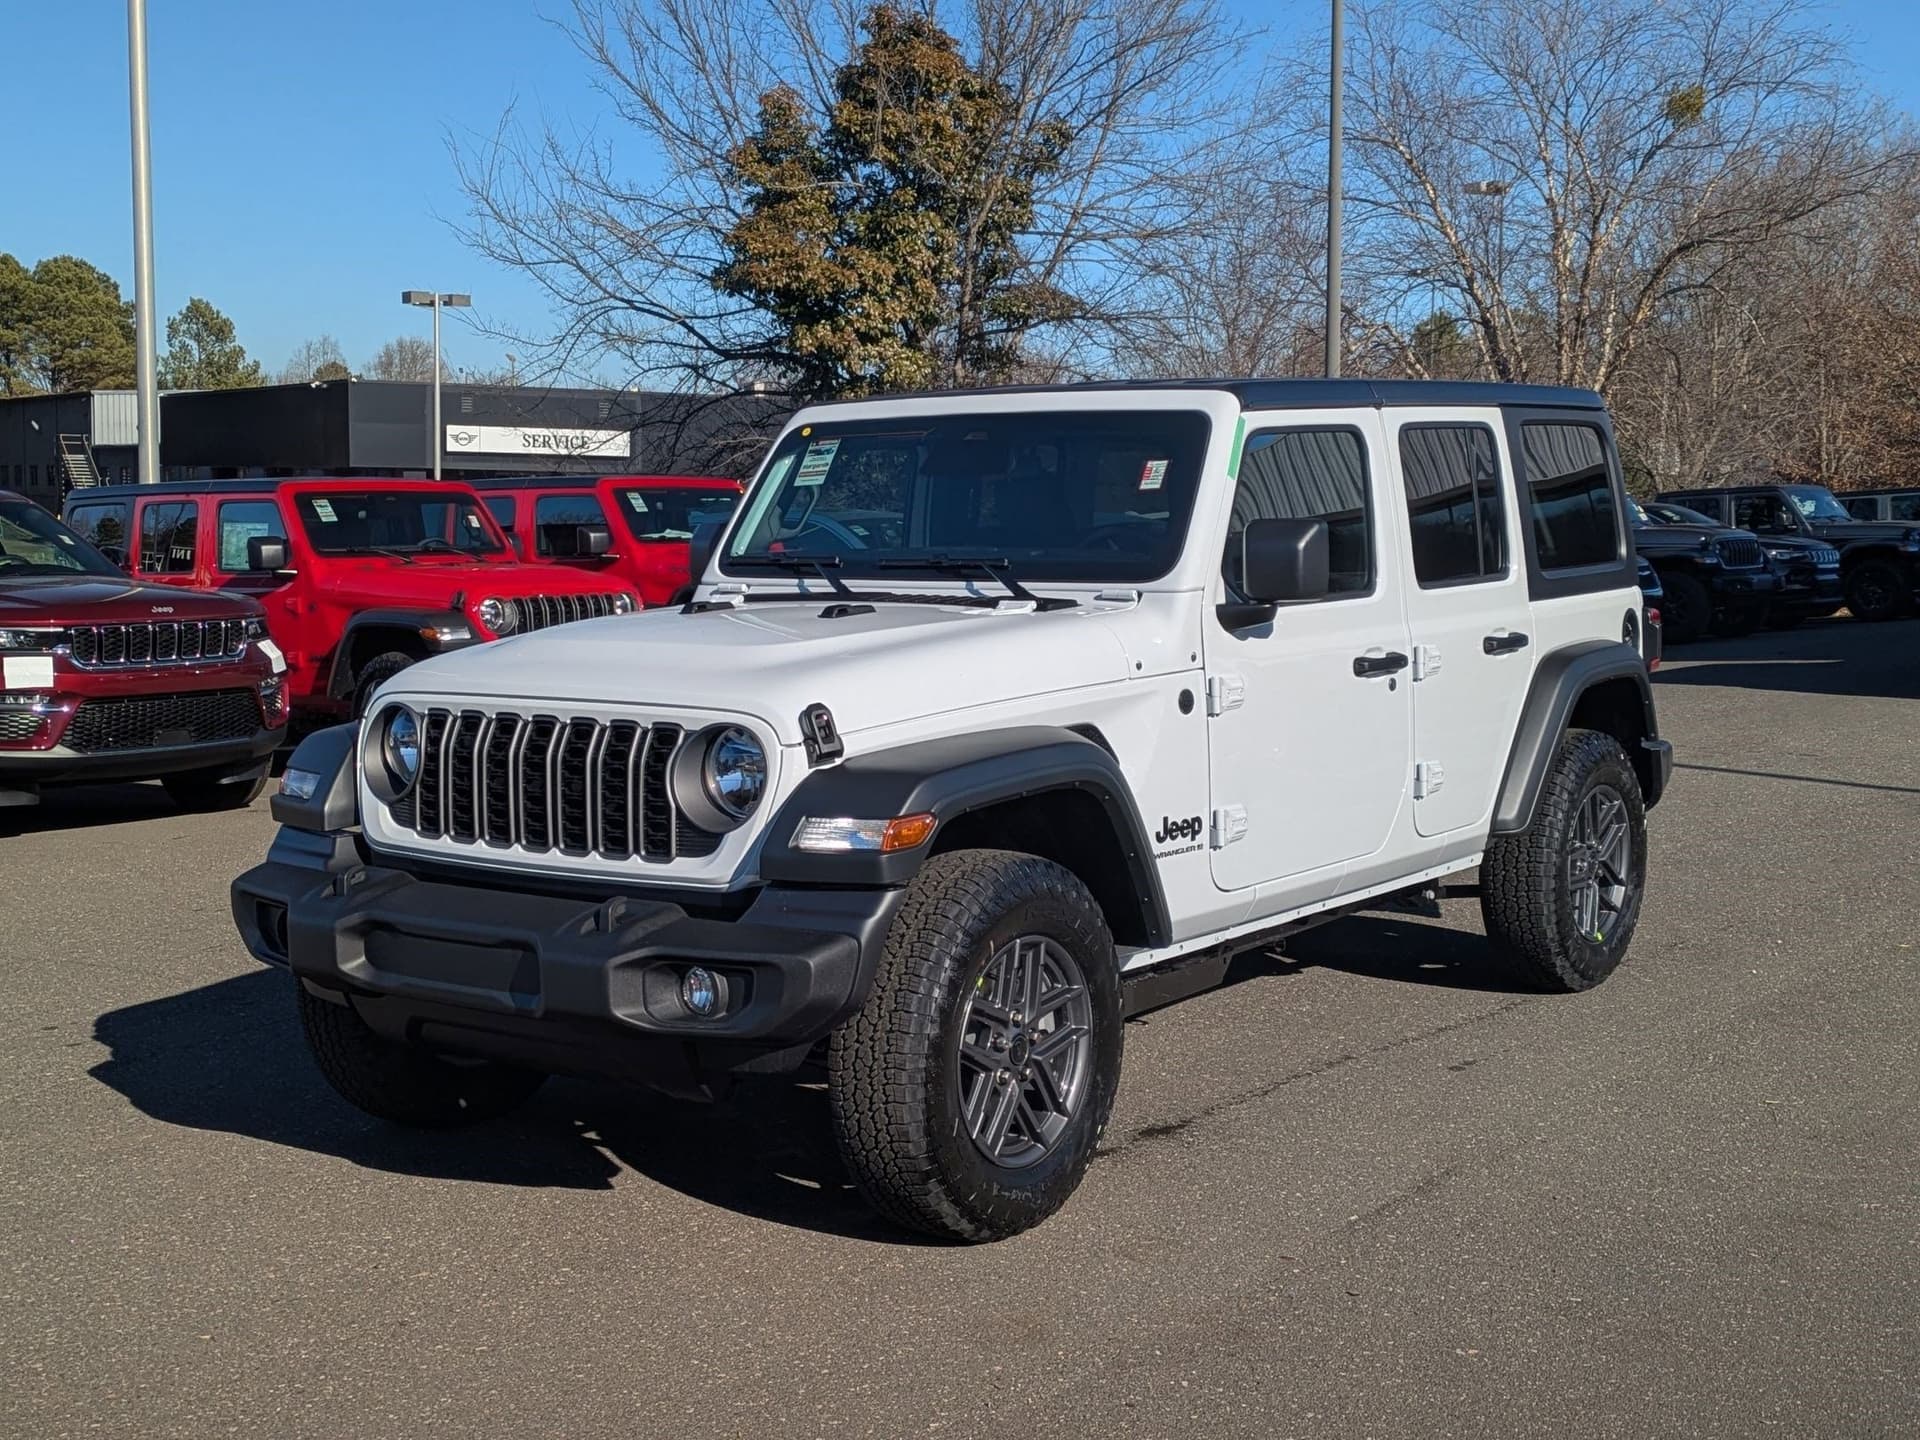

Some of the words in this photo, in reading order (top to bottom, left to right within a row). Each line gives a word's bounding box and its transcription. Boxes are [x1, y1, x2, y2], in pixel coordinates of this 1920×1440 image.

[522, 433, 591, 450] SERVICE
[1155, 815, 1203, 844] Jeep
[1153, 845, 1196, 860] WRANGLER
